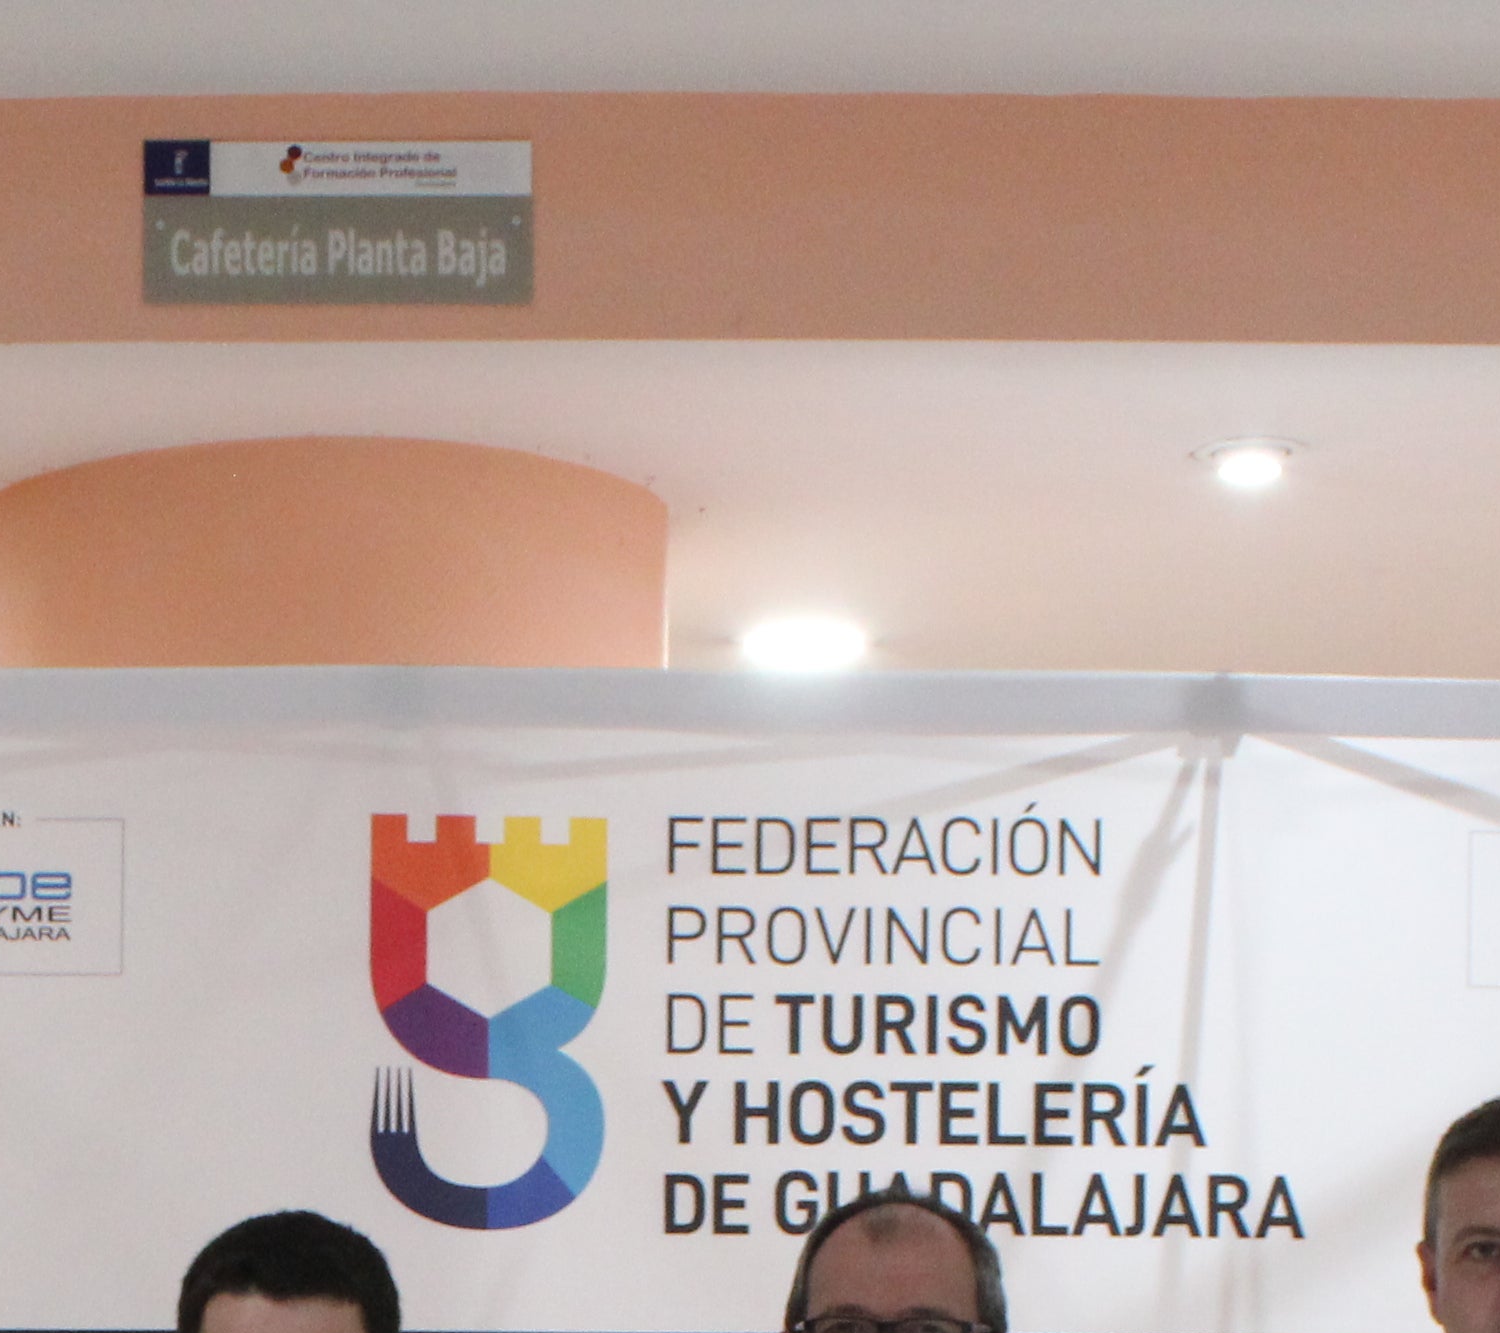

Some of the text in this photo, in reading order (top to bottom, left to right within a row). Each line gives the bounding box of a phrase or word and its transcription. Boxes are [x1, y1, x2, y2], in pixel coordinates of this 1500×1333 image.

[424, 151, 441, 163] de
[170, 224, 508, 288] Cafetería Planta Baja
[667, 802, 1104, 877] FEDERACIÓN
[667, 906, 1101, 967] PROVINCIAL
[667, 993, 1103, 1056] DE TURISMO
[661, 1064, 1208, 1147] Y HOSTELERÍA
[664, 1173, 750, 1235] DE
